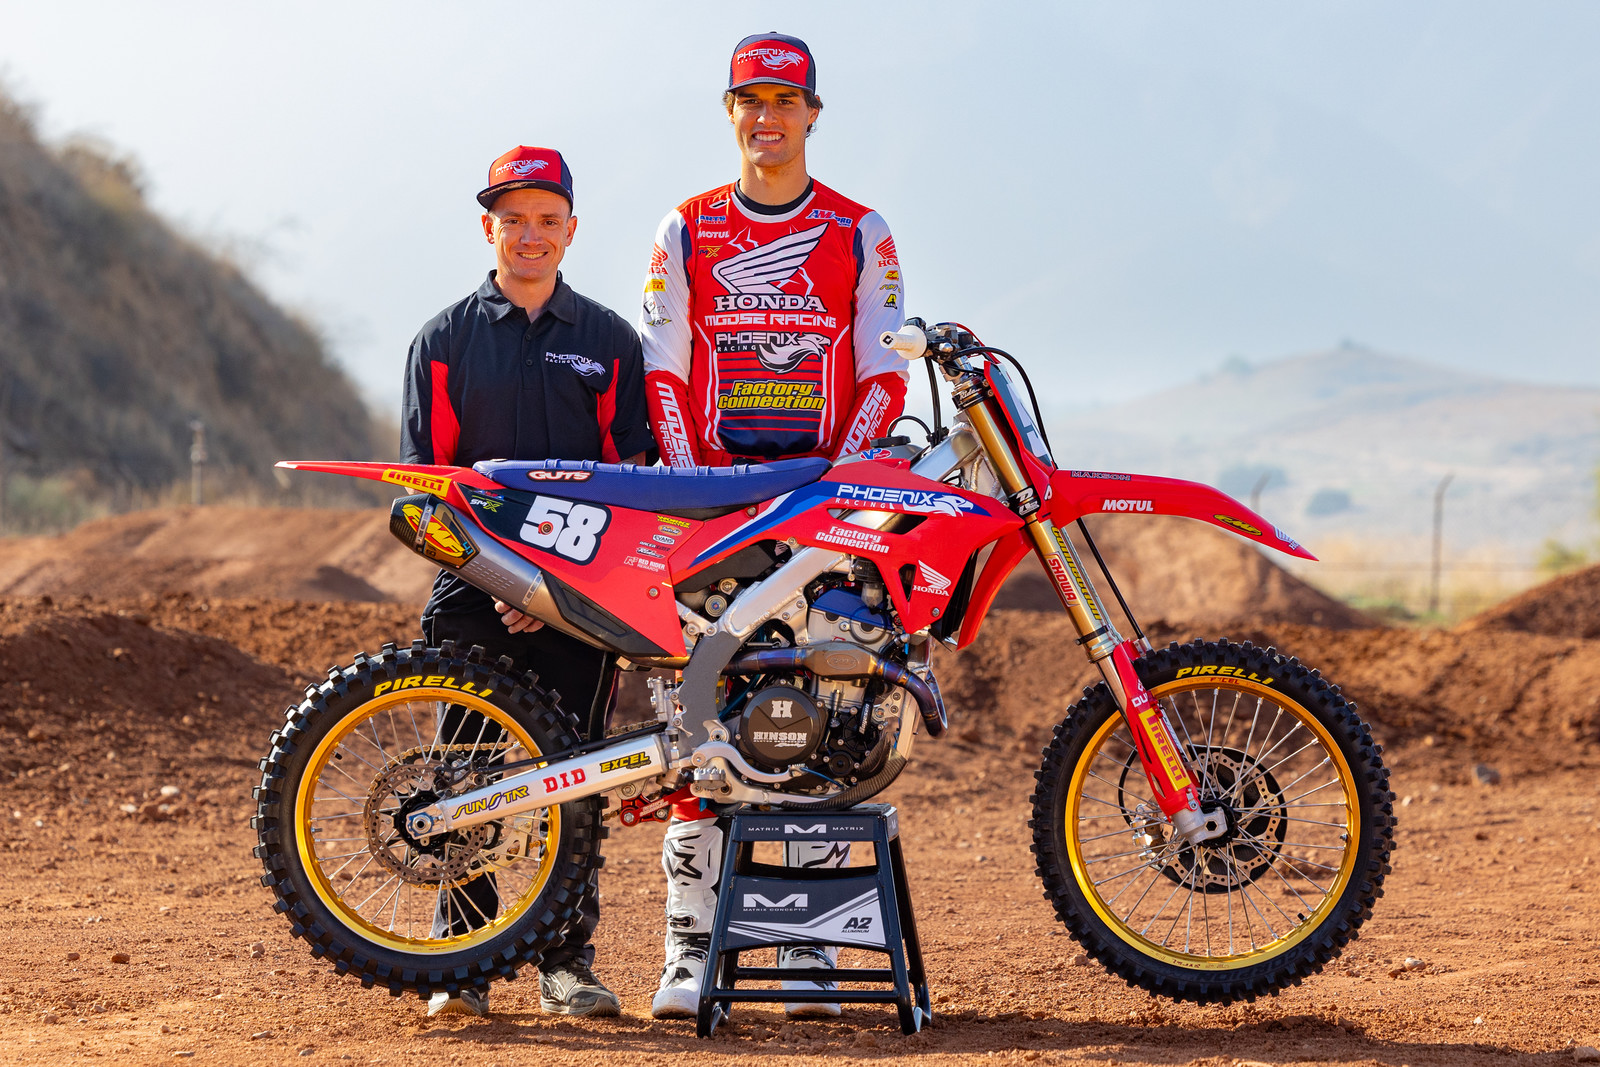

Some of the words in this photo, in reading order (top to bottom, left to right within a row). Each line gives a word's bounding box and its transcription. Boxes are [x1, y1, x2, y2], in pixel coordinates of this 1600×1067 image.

[737, 48, 786, 60] PHOENIX
[713, 294, 828, 312] HONDA
[704, 313, 767, 326] MOOSE
[769, 313, 837, 328] RACING
[715, 332, 799, 345] PHOENIX
[545, 351, 593, 365] PHOENIX
[732, 382, 815, 395] Factory
[717, 395, 826, 409] Connection
[655, 381, 696, 469] MOOSE
[866, 392, 892, 442] RACING
[861, 448, 883, 460] VP
[388, 471, 445, 491] PIRELLI
[528, 470, 592, 480] GUTS
[836, 484, 937, 506] PHOENIX
[470, 497, 502, 513] SMX
[835, 498, 886, 509] RACING
[1102, 499, 1154, 511] MOTUL
[519, 495, 608, 562] 58
[829, 525, 882, 543] Factory
[815, 531, 890, 554] Connection
[638, 558, 650, 566] RED
[649, 560, 666, 570] RIDER
[1048, 558, 1077, 601] SHOWA
[913, 585, 950, 597] HONDA
[1176, 665, 1274, 685] PIRELLI
[373, 675, 493, 698] PIRELLI
[770, 700, 793, 718] H
[753, 731, 808, 741] HINSON
[1146, 714, 1187, 782] PIRELLI
[543, 768, 586, 793] D.I.D
[600, 752, 650, 773] EXCEL
[843, 917, 872, 929] A2
